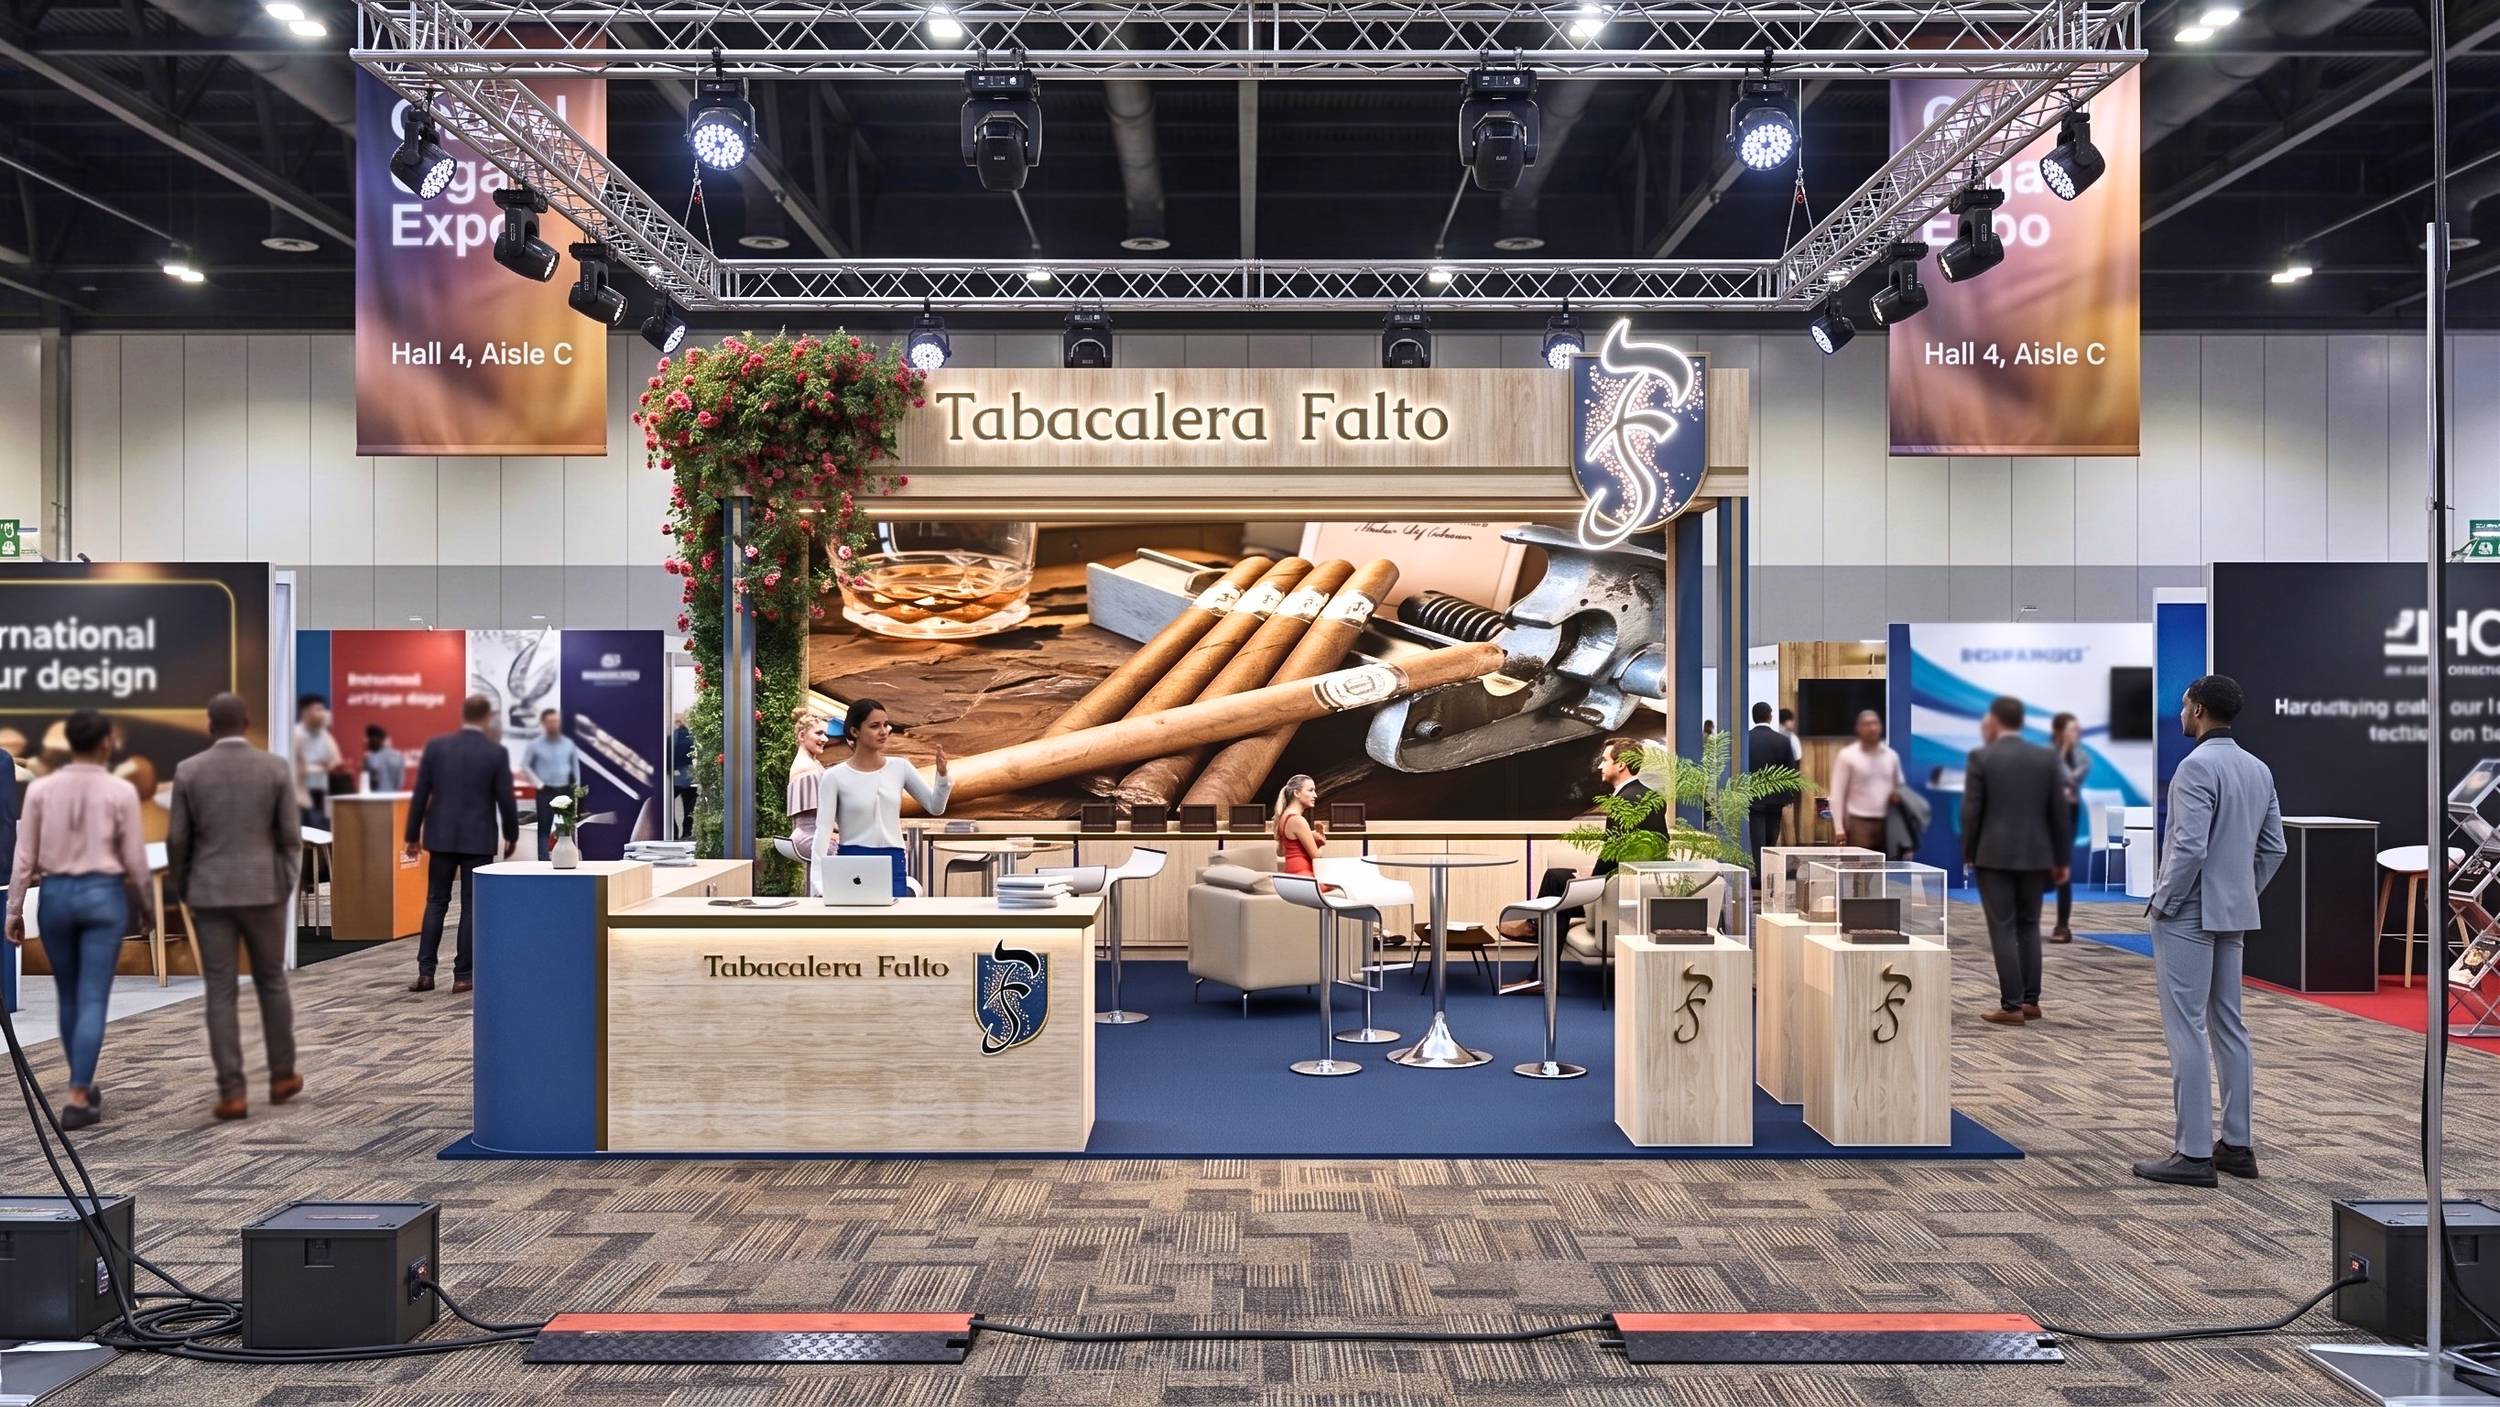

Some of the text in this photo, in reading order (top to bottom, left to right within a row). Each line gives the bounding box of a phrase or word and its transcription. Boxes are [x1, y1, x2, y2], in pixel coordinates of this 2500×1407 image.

[392, 341, 572, 369] Hall 4, Aisle C
[1925, 341, 2105, 369] Hall 4, Aisle C
[936, 392, 1449, 441] Tabacalera Falto
[36, 658, 157, 697] design
[703, 955, 949, 978] Tabacalera Falto
